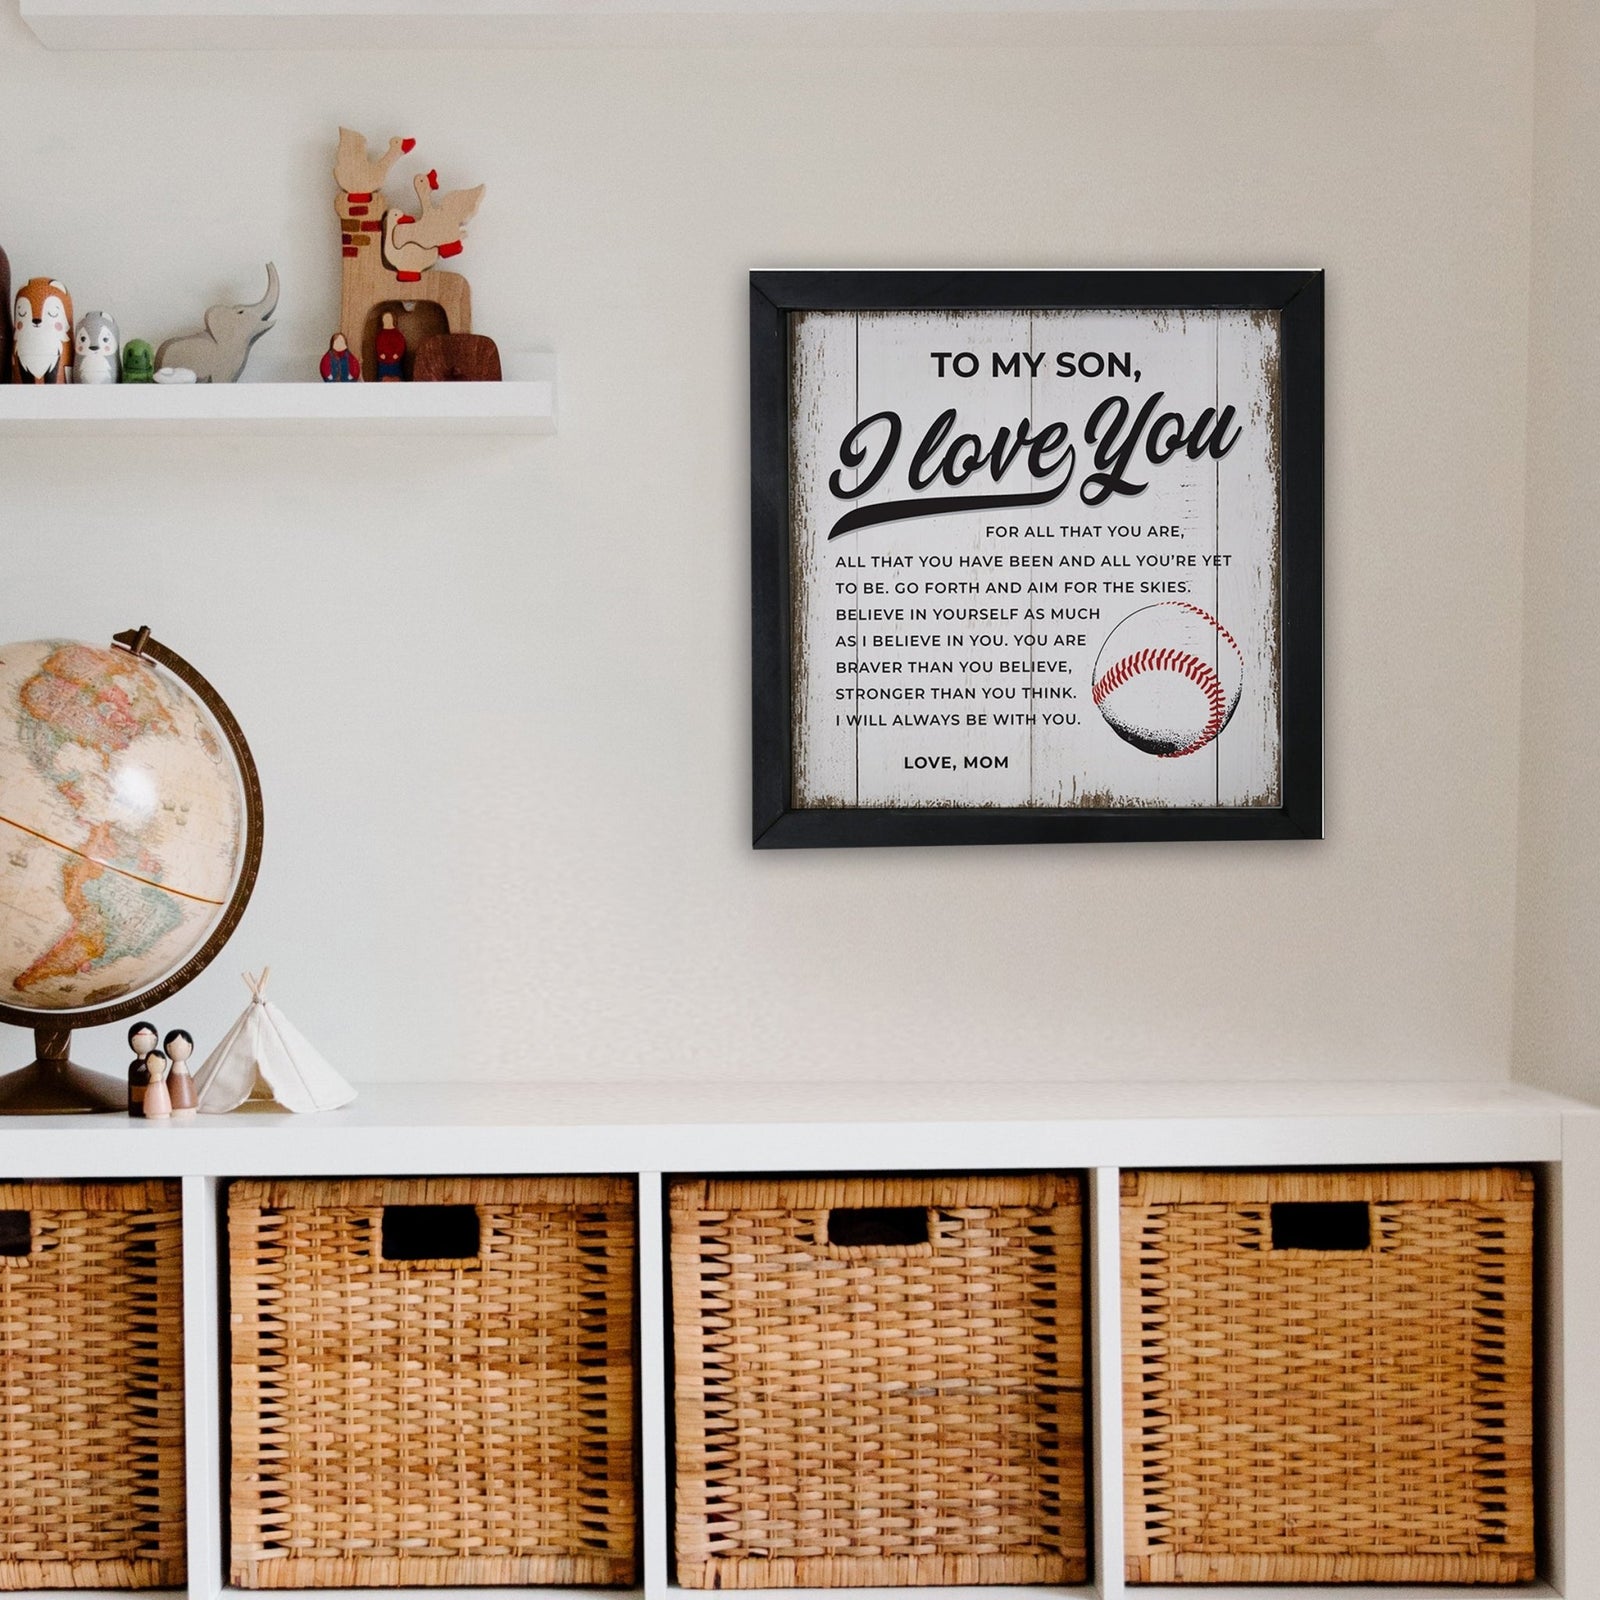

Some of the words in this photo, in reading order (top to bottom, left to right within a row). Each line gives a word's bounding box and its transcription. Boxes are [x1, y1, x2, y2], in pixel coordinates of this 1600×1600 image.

[931, 351, 980, 378] TO
[993, 351, 1046, 378] MY
[1056, 351, 1142, 383] SON,
[828, 411, 902, 500] I
[904, 408, 1076, 503] love
[1079, 391, 1243, 506] You
[986, 526, 1020, 538] FOR
[1025, 526, 1055, 538] ALL
[1061, 525, 1102, 538] THAT
[1108, 525, 1142, 538] YOU
[1148, 525, 1184, 540] ARE,
[836, 556, 865, 568] ALL
[871, 555, 913, 568] THAT
[919, 555, 953, 568] YOU
[960, 555, 1003, 568] HAVE
[1010, 555, 1053, 568] BEEN
[1060, 555, 1095, 567] AND
[1101, 555, 1130, 567] ALL
[1136, 554, 1196, 567] YOU'RE
[1202, 554, 1231, 567] YET
[836, 582, 858, 595] TO
[864, 582, 888, 595] BE.
[895, 582, 919, 594] GO
[925, 582, 979, 594] FORTH
[986, 582, 1021, 594] AND
[1028, 581, 1057, 594] AIM
[1064, 581, 1097, 594] FOR
[1104, 581, 1134, 593] THE
[1141, 581, 1191, 594] SKIES.
[836, 608, 904, 621] BELIEVE
[911, 608, 927, 621] IN
[933, 608, 1018, 621] YOURSELF
[1024, 608, 1045, 620] AS
[1051, 608, 1100, 620] MUCH
[836, 635, 856, 647] AS
[861, 636, 867, 647] I
[873, 635, 941, 647] BELIEVE
[947, 635, 963, 647] IN
[969, 634, 1008, 647] YOU.
[1013, 634, 1048, 647] YOU
[1054, 634, 1086, 646] ARE
[836, 661, 902, 674] BRAVER
[908, 661, 953, 673] THAN
[959, 661, 993, 673] YOU
[1000, 660, 1072, 675] BELIEVE,
[836, 687, 925, 700] STRONGER
[931, 687, 976, 700] THAN
[982, 687, 1016, 700] YOU
[1021, 687, 1077, 699] THINK.
[835, 715, 841, 726] I
[846, 713, 886, 726] WILL
[893, 714, 960, 726] ALWAYS
[966, 713, 986, 726] BE
[993, 713, 1036, 726] WITH
[1042, 713, 1080, 726] YOU.
[904, 756, 957, 772] LOVE,
[964, 755, 1009, 769] MOM
